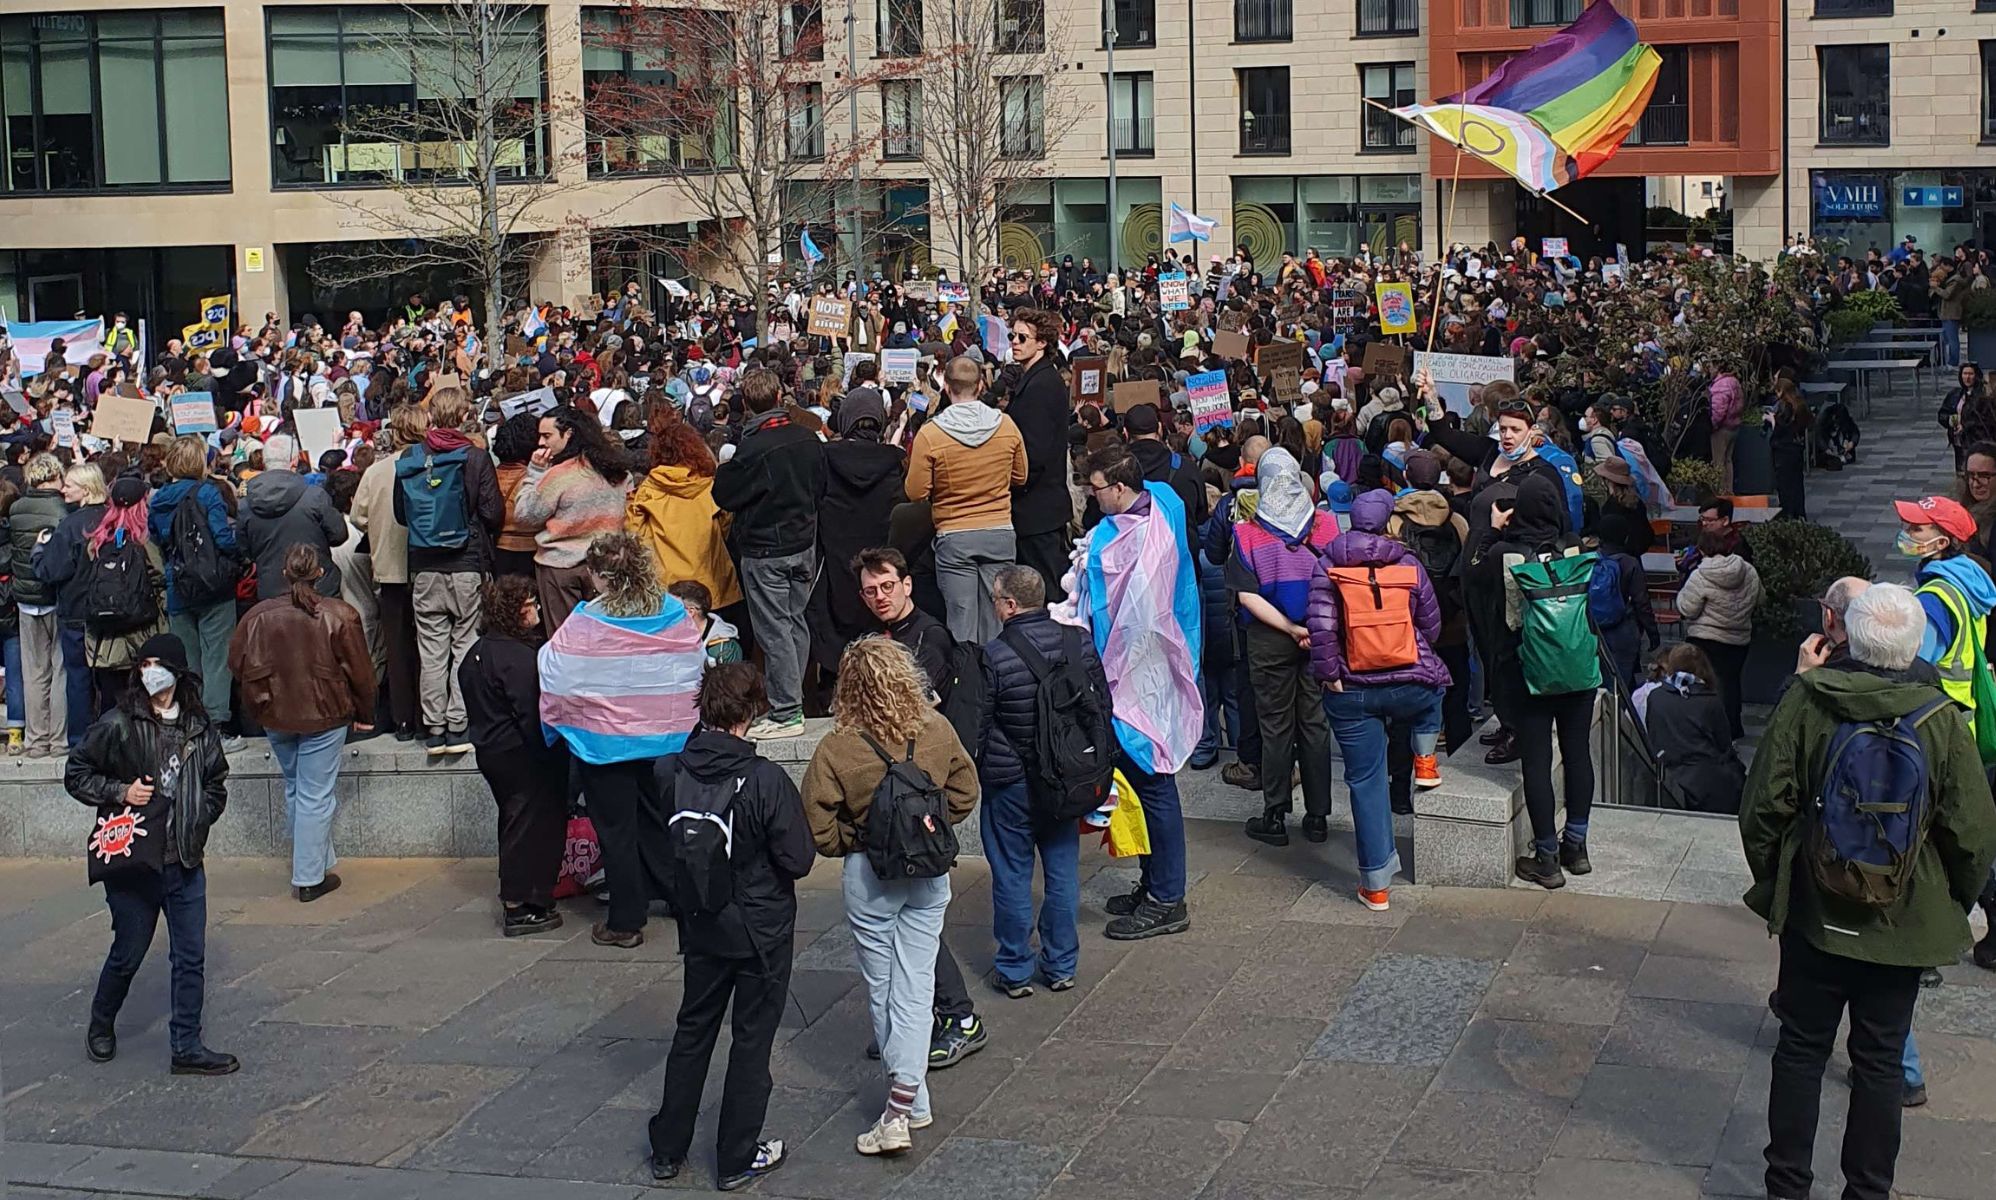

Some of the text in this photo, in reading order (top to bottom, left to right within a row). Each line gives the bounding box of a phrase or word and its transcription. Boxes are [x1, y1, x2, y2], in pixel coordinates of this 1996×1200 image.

[1827, 185, 1877, 203] VMH
[1826, 203, 1879, 211] SOLICITORS
[1335, 290, 1354, 298] TRANS
[1162, 302, 1187, 310] NEED
[1337, 307, 1351, 316] ARE
[1450, 368, 1498, 381] OLIGARCHY
[1197, 412, 1230, 431] EXIST
[563, 837, 601, 864] rcy
